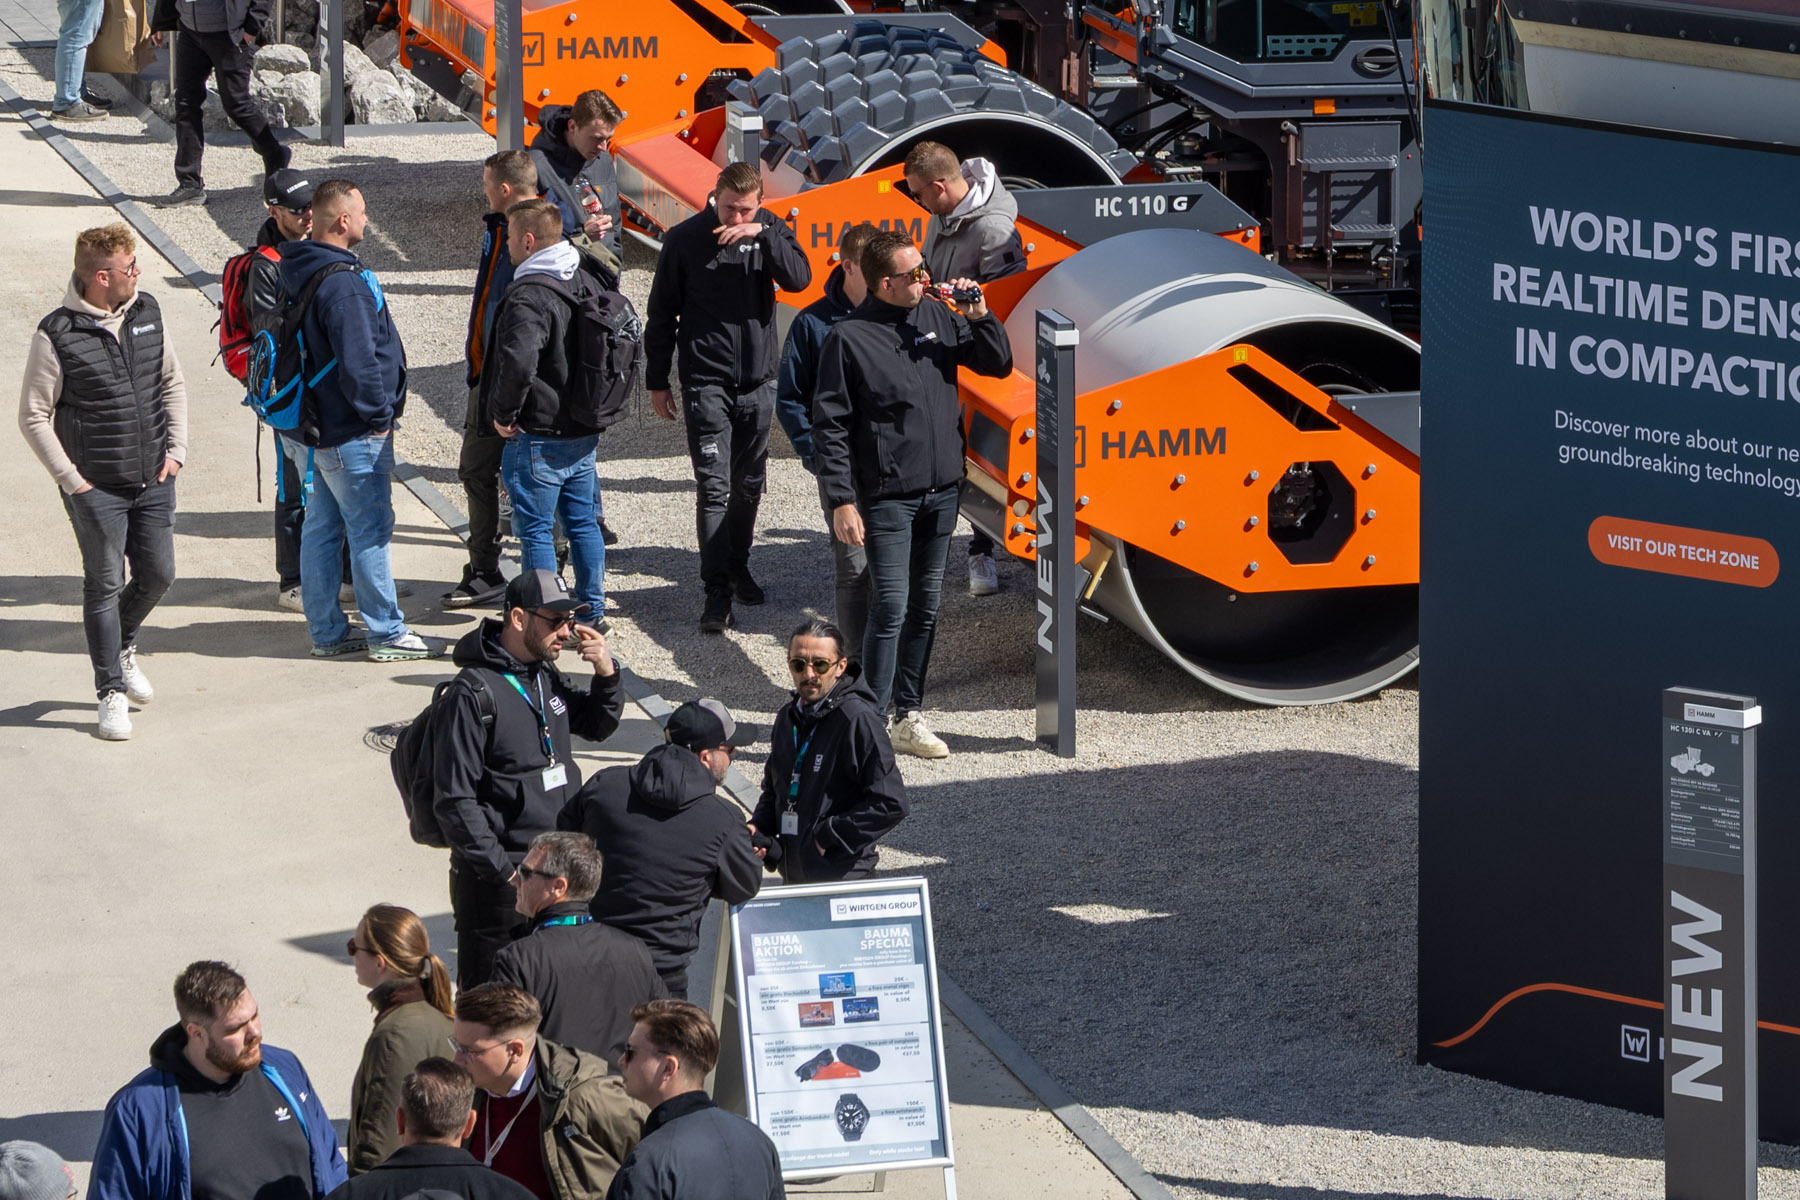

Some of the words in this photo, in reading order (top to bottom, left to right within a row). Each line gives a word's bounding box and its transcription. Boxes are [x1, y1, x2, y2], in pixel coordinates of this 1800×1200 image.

[557, 36, 659, 60] HAMM
[1095, 196, 1124, 218] HC
[1127, 195, 1167, 217] 110
[1529, 205, 1719, 269] WORLD'S
[1492, 262, 1689, 327] REALTIME
[1515, 327, 1556, 369] IN
[1101, 426, 1228, 461] HAMM
[1554, 410, 1630, 441] Discover
[1633, 422, 1680, 446] more
[1685, 426, 1739, 454] about
[1742, 438, 1774, 460] our
[1558, 442, 1701, 483] groundbreaking
[1037, 476, 1054, 655] NEW
[1607, 533, 1642, 553] VISIT
[1645, 539, 1677, 558] OUR
[1679, 543, 1718, 564] TECH
[1719, 549, 1760, 570] ZONE
[1696, 711, 1715, 719] HAMM
[849, 903, 887, 913] WIRTGEN
[888, 901, 918, 911] GROUP
[754, 934, 800, 947] BAUMA
[864, 927, 911, 940] BAUMA
[754, 944, 803, 957] AKTION
[860, 938, 911, 950] SPECIAL
[1671, 890, 1724, 1103] NEW
